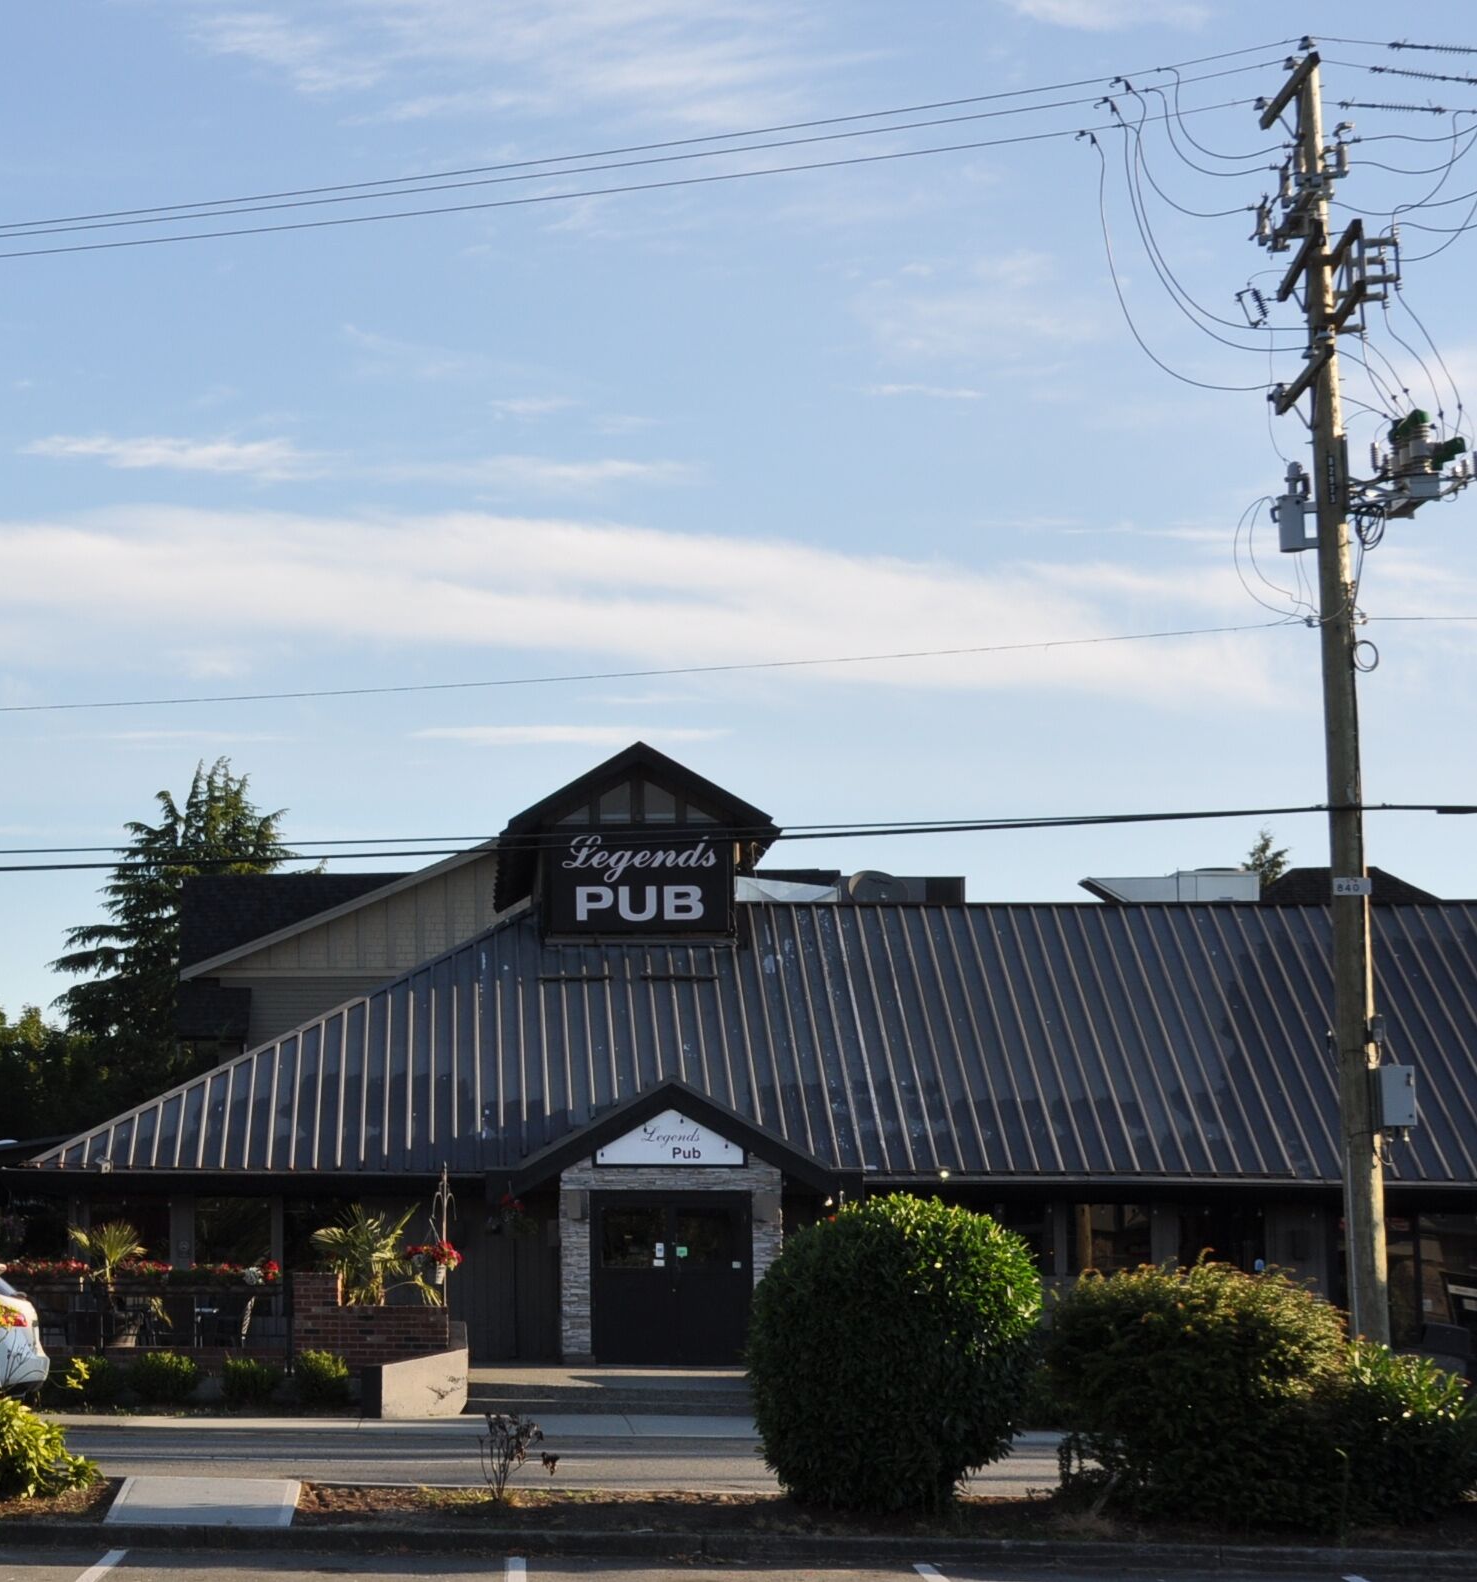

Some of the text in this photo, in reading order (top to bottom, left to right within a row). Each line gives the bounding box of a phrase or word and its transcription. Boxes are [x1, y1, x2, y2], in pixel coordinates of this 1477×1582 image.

[562, 835, 717, 882] Legends
[576, 885, 704, 922] PUB
[641, 1124, 701, 1148] Legends
[672, 1147, 701, 1159] Pub
